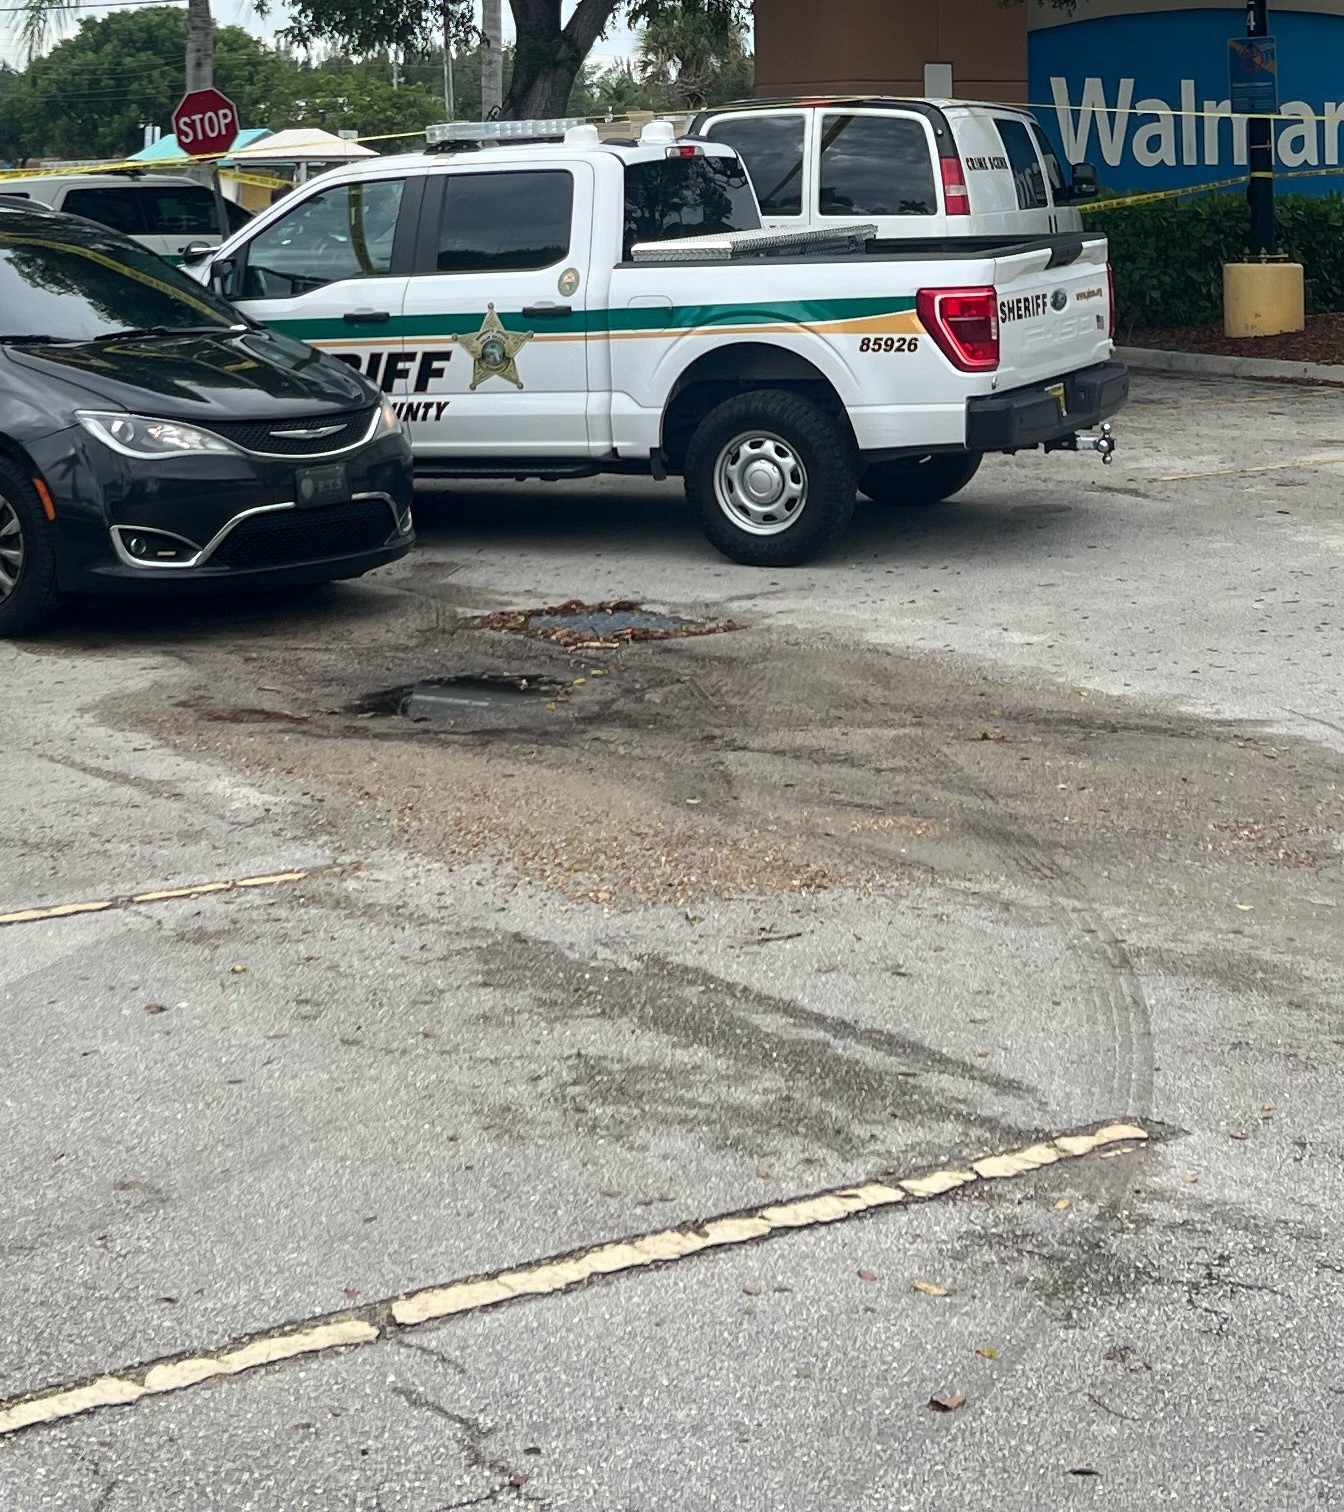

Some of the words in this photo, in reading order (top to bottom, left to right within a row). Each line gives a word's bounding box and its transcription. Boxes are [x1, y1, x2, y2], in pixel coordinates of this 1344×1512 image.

[179, 108, 232, 143] STOP
[1000, 293, 1047, 323] SHERIFF
[859, 337, 919, 353] 85926
